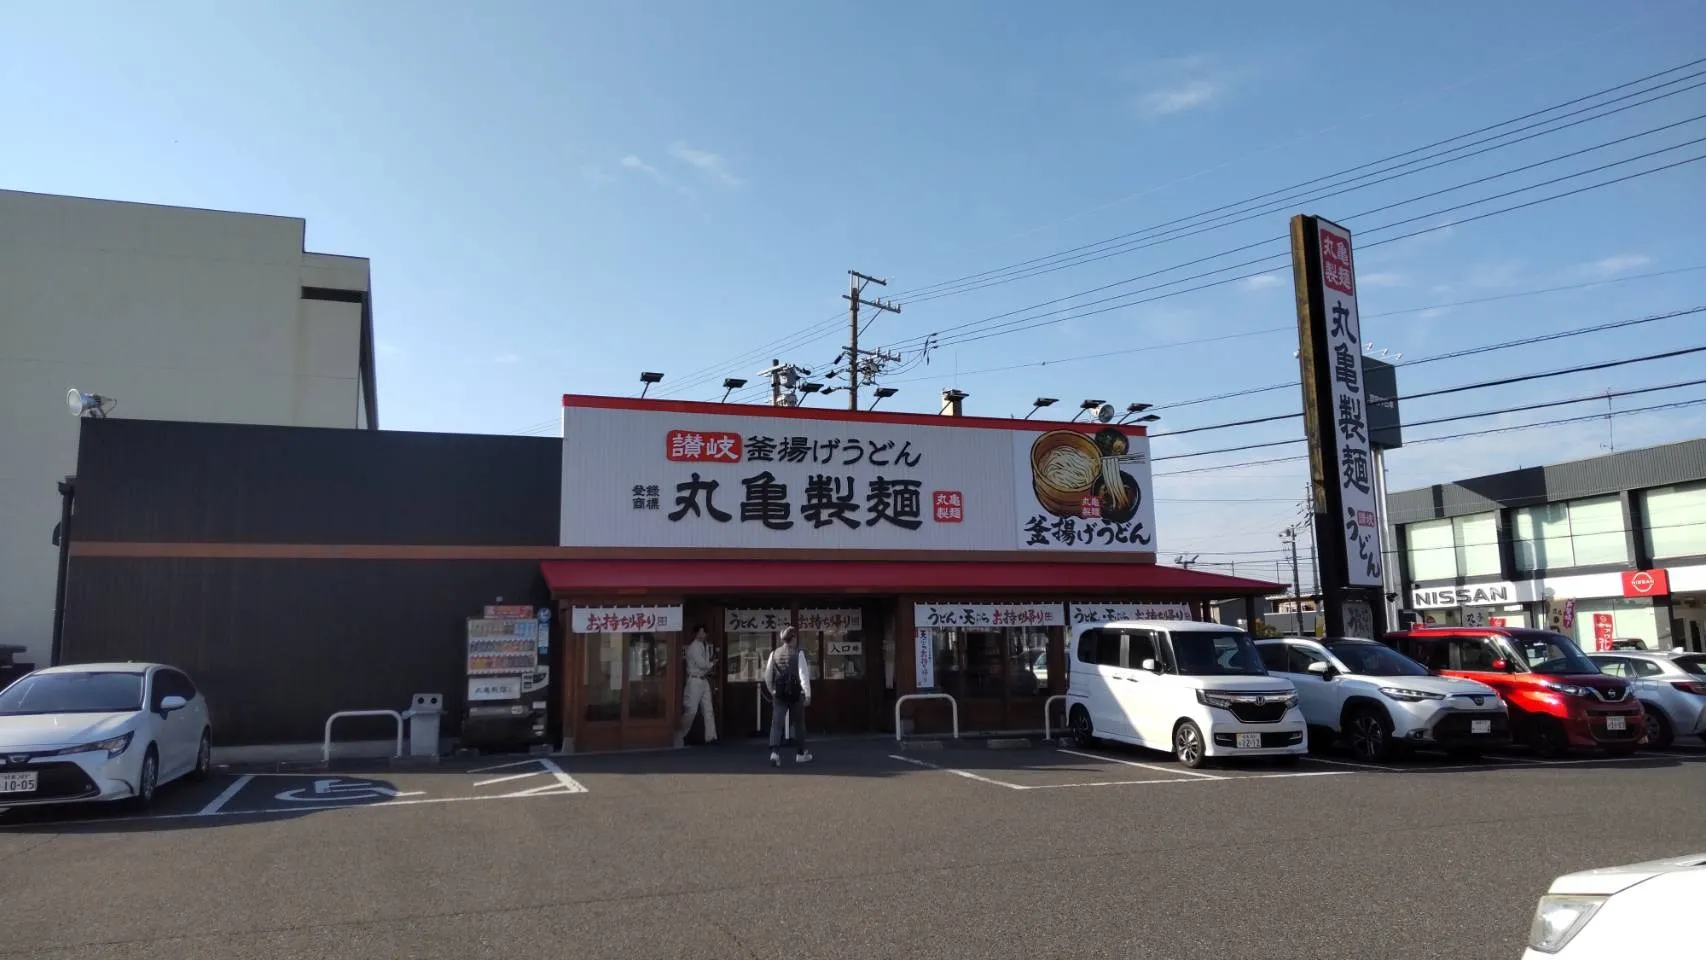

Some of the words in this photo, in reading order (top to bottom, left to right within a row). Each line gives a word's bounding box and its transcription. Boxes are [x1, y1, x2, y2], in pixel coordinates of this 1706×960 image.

[1323, 236, 1349, 266] 丸亀
[1331, 300, 1371, 494] 丸亀製麺
[672, 433, 739, 460] 讃岐
[743, 435, 922, 467] 釜揚げうどん
[668, 470, 923, 531] 丸亀製麺
[937, 493, 960, 506] 丸亀
[1024, 515, 1151, 545] 釜揚げうどん
[1346, 507, 1380, 578] うどん
[1415, 587, 1507, 605] NISSAN
[586, 611, 655, 632] お持ち帰り
